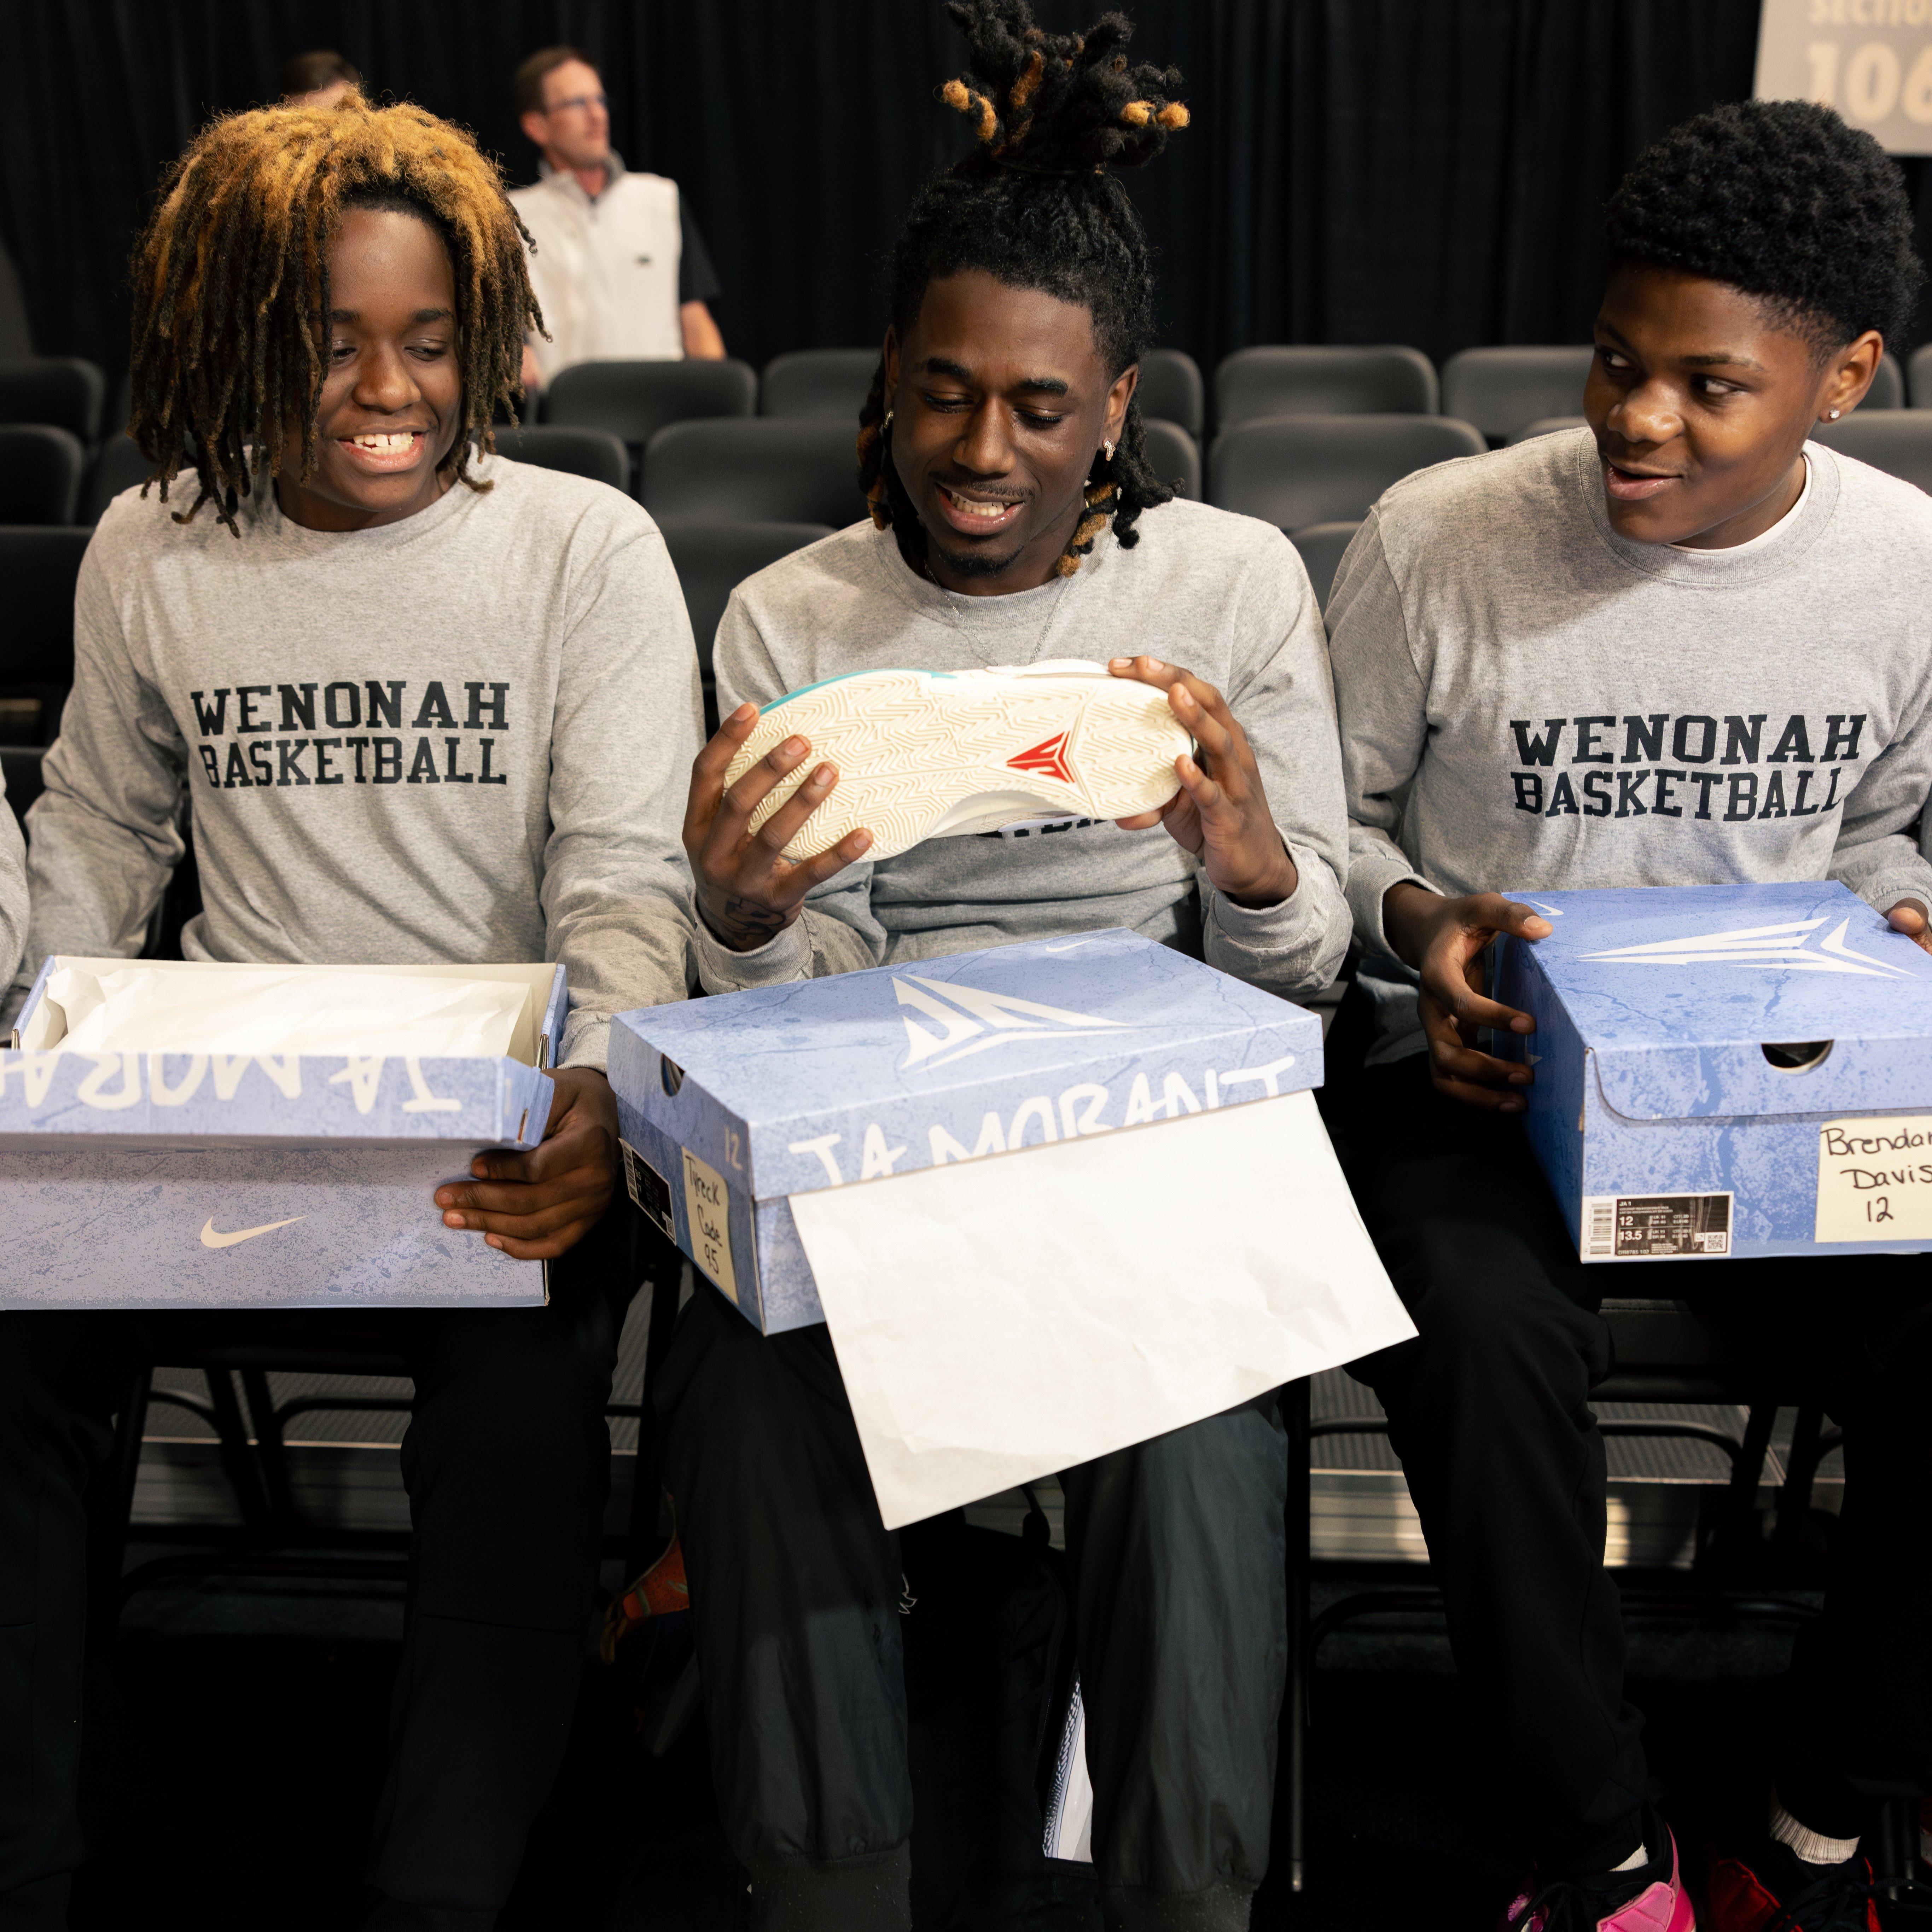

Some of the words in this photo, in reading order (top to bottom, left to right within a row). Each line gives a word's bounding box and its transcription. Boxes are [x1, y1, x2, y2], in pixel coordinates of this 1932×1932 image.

[191, 681, 510, 737] WENONAH
[198, 736, 507, 788] BASKETBALL
[1510, 714, 1867, 766] WENONAH
[1510, 767, 1843, 822] BASKETBALL
[724, 1125, 743, 1170] 12
[1840, 1165, 1932, 1189] Davis
[1619, 1216, 1634, 1226] 12
[1867, 1197, 1894, 1222] 12
[1620, 1230, 1643, 1241] 13.5
